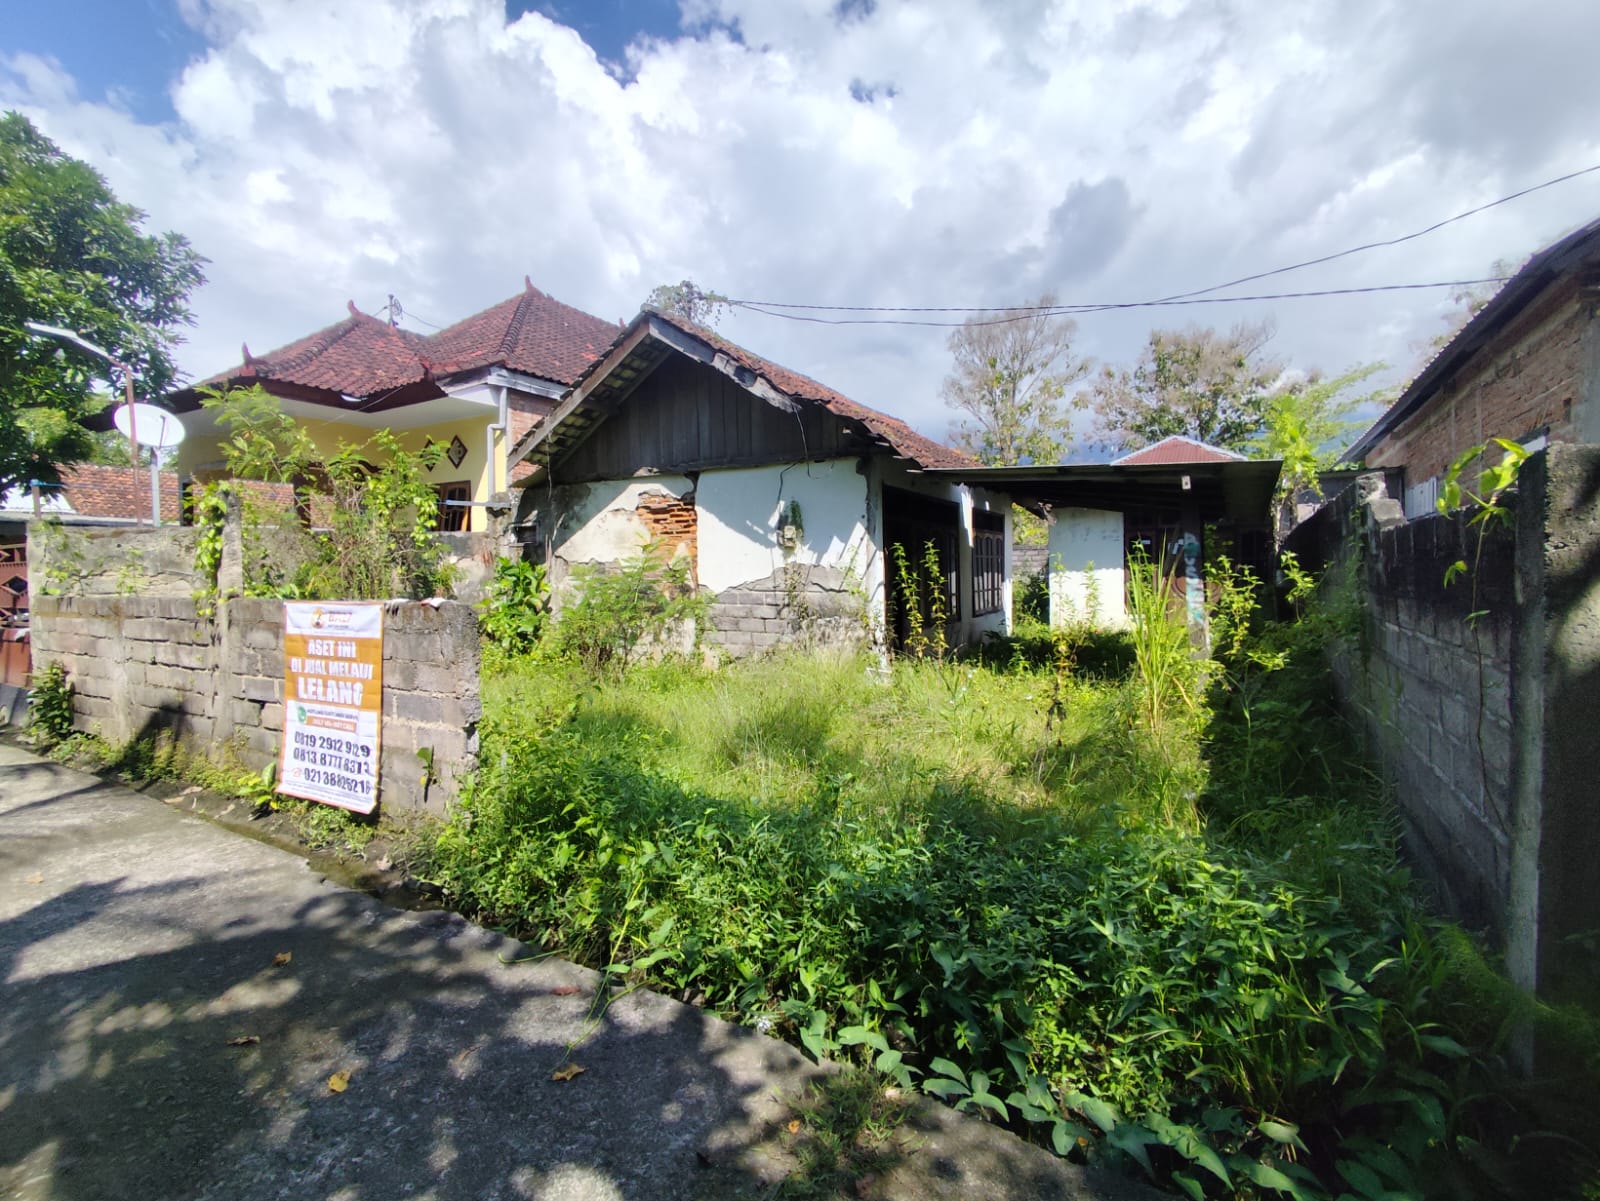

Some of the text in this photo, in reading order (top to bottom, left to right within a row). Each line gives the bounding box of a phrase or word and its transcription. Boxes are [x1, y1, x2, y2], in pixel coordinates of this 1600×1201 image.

[307, 639, 357, 658] ASET INI
[290, 658, 302, 673] DI
[304, 659, 327, 675] JUAL
[297, 677, 364, 706] LELANG
[318, 736, 343, 752] 2912
[293, 747, 317, 764] 0813
[304, 767, 321, 784] 021
